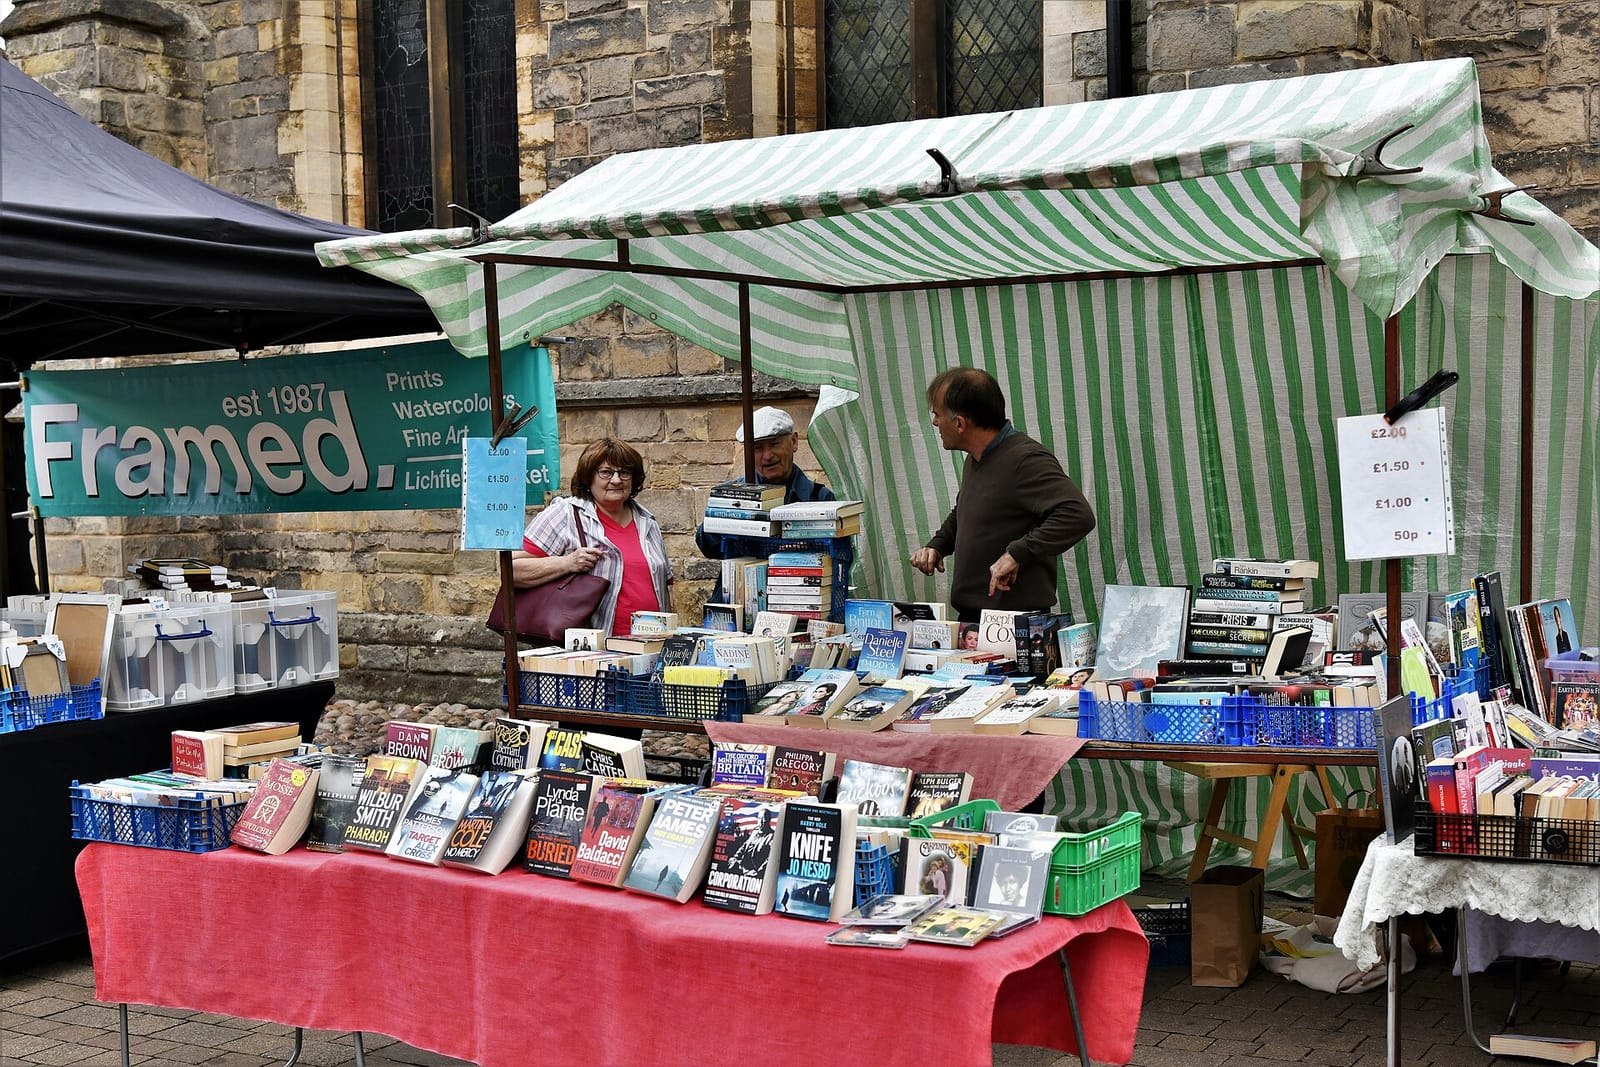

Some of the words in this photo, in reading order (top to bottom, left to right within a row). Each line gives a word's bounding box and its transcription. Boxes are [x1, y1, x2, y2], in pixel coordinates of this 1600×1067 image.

[386, 370, 444, 391] Prints
[222, 389, 261, 418] est
[267, 383, 326, 415] 1987
[393, 393, 515, 420] Watercolos
[402, 429, 441, 448] Fine
[1371, 426, 1406, 439] £2.00
[30, 390, 394, 497] Framed.
[488, 448, 509, 456] £2.00
[1373, 461, 1410, 473] £1.50
[405, 470, 463, 490] Lichfie
[488, 475, 509, 483] £1.50
[487, 503, 508, 511] £1.00
[1376, 497, 1412, 509] £1.00
[495, 529, 509, 537] 50p
[1394, 531, 1418, 542] 50p
[858, 606, 876, 617] Fern
[1221, 614, 1248, 626] CRISIS
[864, 632, 904, 649] Danielle
[714, 648, 752, 659] NADINE
[868, 644, 896, 658] Steel
[398, 731, 421, 743] DAN
[388, 741, 428, 760] BROWN
[498, 742, 520, 757] Bernard
[590, 750, 614, 765] CHRIS
[784, 752, 814, 762] PHILIPPA
[492, 750, 524, 770] Cornwell
[585, 758, 625, 778] CARTER
[775, 758, 822, 772] GREGORY
[717, 764, 765, 776] BRITAIN
[264, 780, 296, 796] MOSSE
[546, 784, 580, 802] Lynda
[358, 789, 404, 810] WILBUR
[354, 806, 394, 828] SMITH
[535, 796, 585, 822] Plante
[662, 798, 714, 824] PETER
[402, 818, 450, 834] PATTERSON
[414, 812, 442, 825] JAMES
[458, 819, 494, 832] MARTINA
[655, 814, 707, 838] JAMES
[344, 826, 390, 844] PHARAOH
[408, 830, 442, 845] TARGET
[451, 829, 490, 848] COLE
[598, 830, 630, 850] David
[404, 848, 432, 860] CROSS
[414, 842, 438, 853] ALEX
[444, 848, 458, 856] NO
[457, 848, 480, 858] MERCY
[527, 840, 577, 866] BURIED
[576, 842, 624, 866] Baldacci
[789, 832, 834, 862] KNIFE
[590, 864, 617, 882] family
[786, 859, 800, 875] JO
[801, 860, 830, 880] NESBO
[708, 870, 762, 894] CORPORATION
